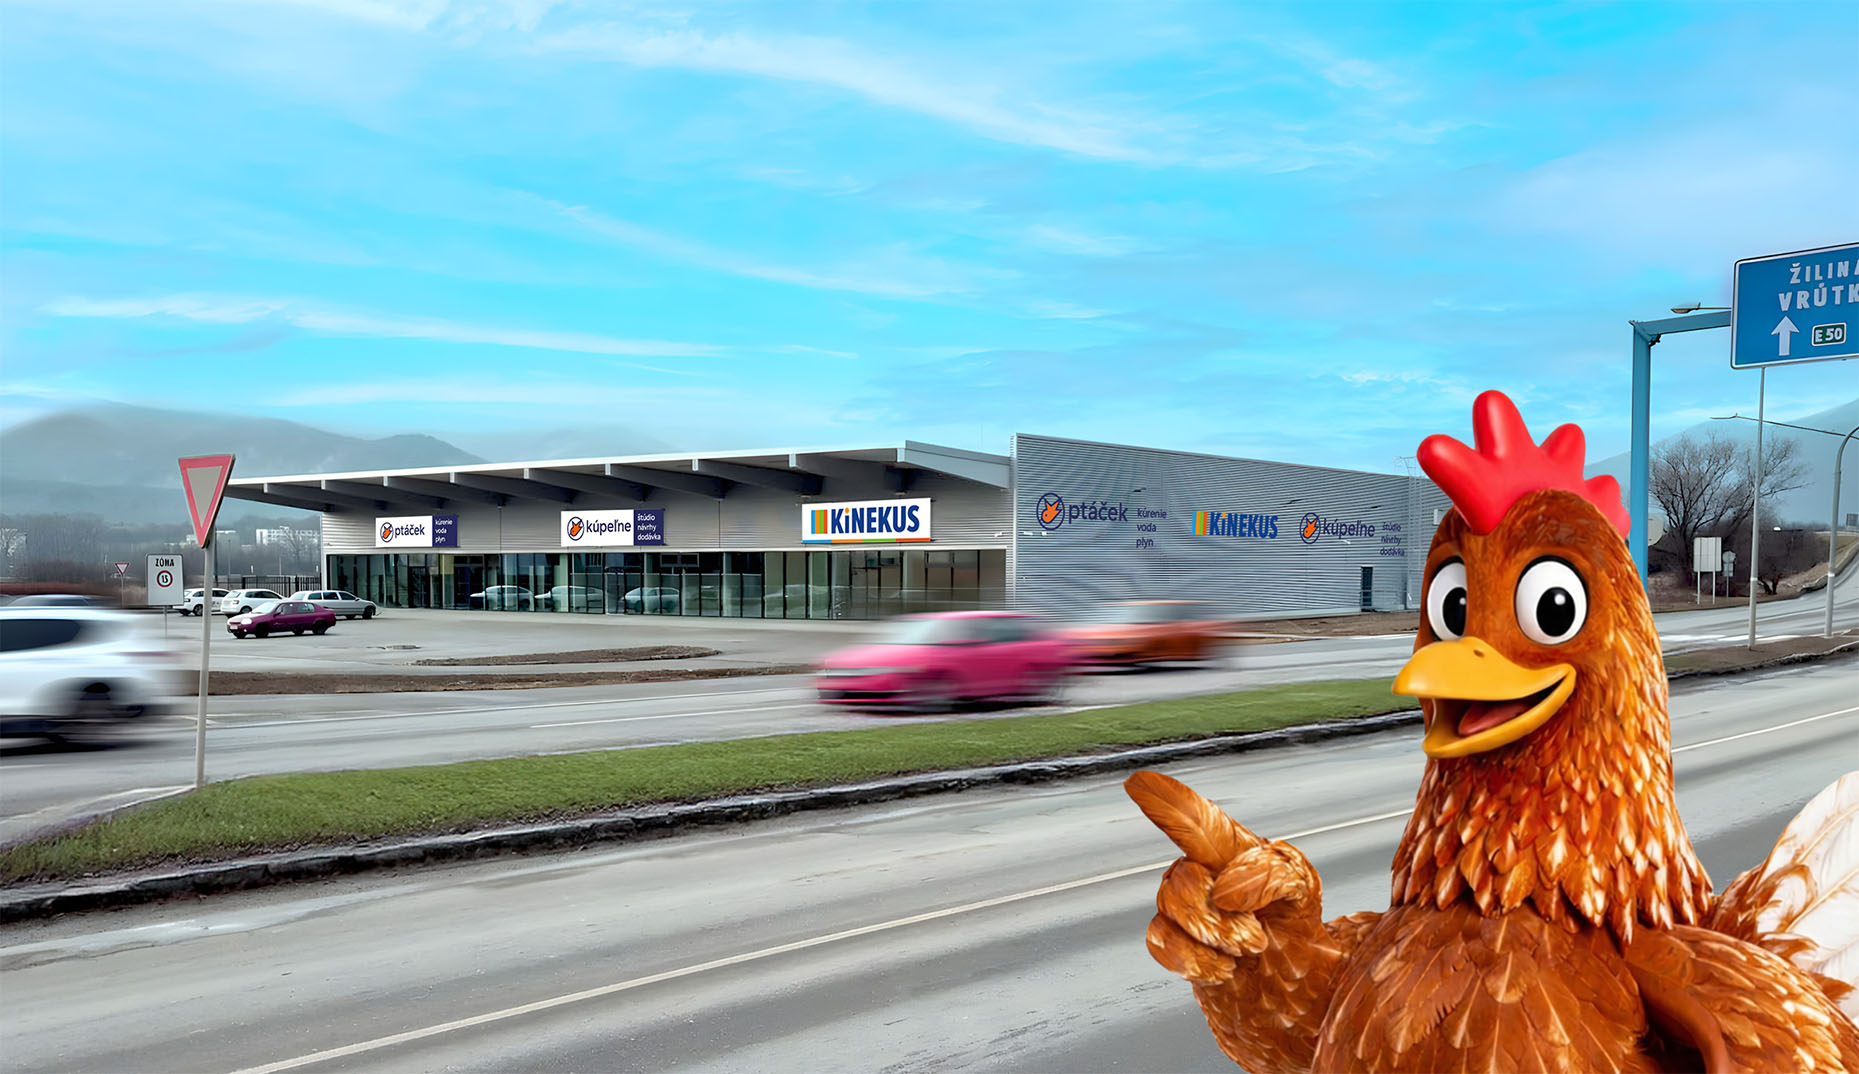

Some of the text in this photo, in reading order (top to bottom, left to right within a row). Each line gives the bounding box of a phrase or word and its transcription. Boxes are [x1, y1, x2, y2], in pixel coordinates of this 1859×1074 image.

[637, 513, 655, 521] štúdio
[1068, 501, 1129, 524] ptáček
[1137, 508, 1167, 519] kúrenie
[395, 524, 425, 538] ptáček
[586, 519, 631, 535] kúpeľne
[1136, 523, 1157, 533] voda
[1323, 518, 1376, 539] kúpeľne
[637, 533, 661, 541] dodávka
[1136, 537, 1154, 549] plyn
[161, 574, 169, 583] 15
